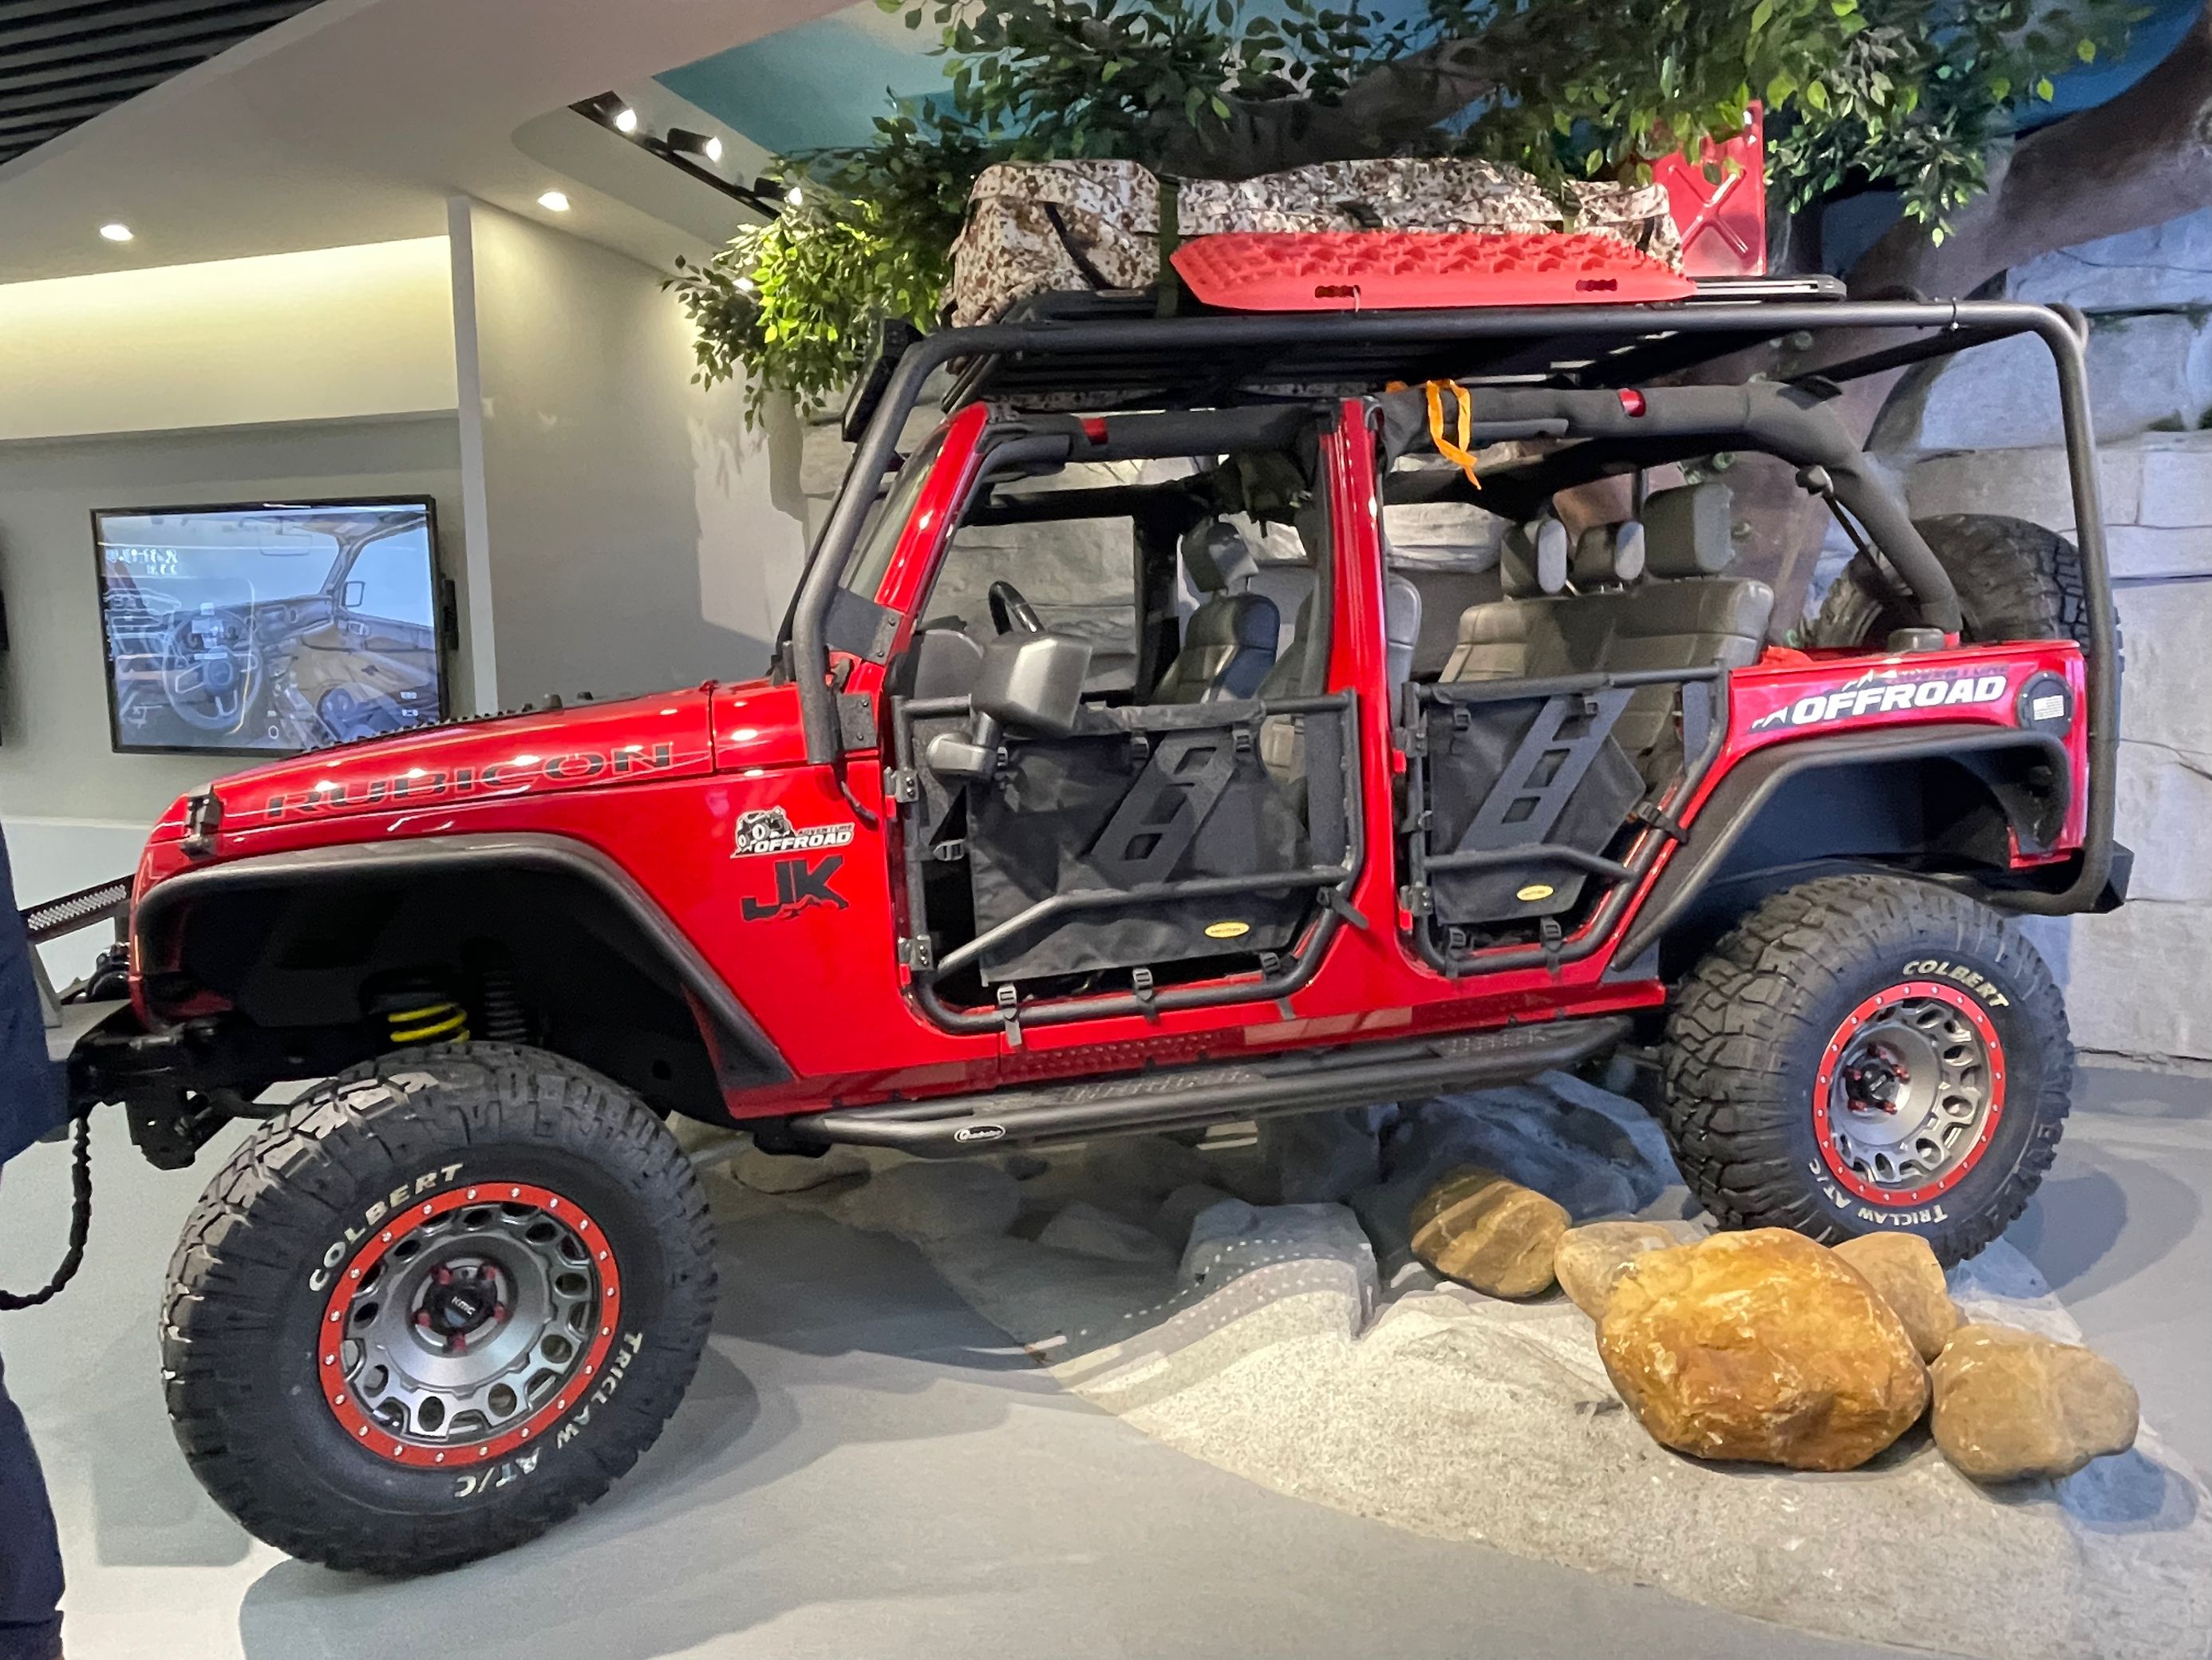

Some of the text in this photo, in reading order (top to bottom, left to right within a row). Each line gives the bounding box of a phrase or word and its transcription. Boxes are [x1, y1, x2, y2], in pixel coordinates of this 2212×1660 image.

[1791, 676, 2008, 725] OFFROAD
[263, 742, 673, 821] RUBICON
[754, 832, 851, 853] OFFROAD
[743, 856, 849, 921] JK
[1902, 960, 2009, 1008] COLBERT
[309, 1163, 464, 1291] COLBERT
[1858, 1205, 1948, 1226] TRICLAW
[455, 1332, 643, 1497] TRICLAW AT/C
